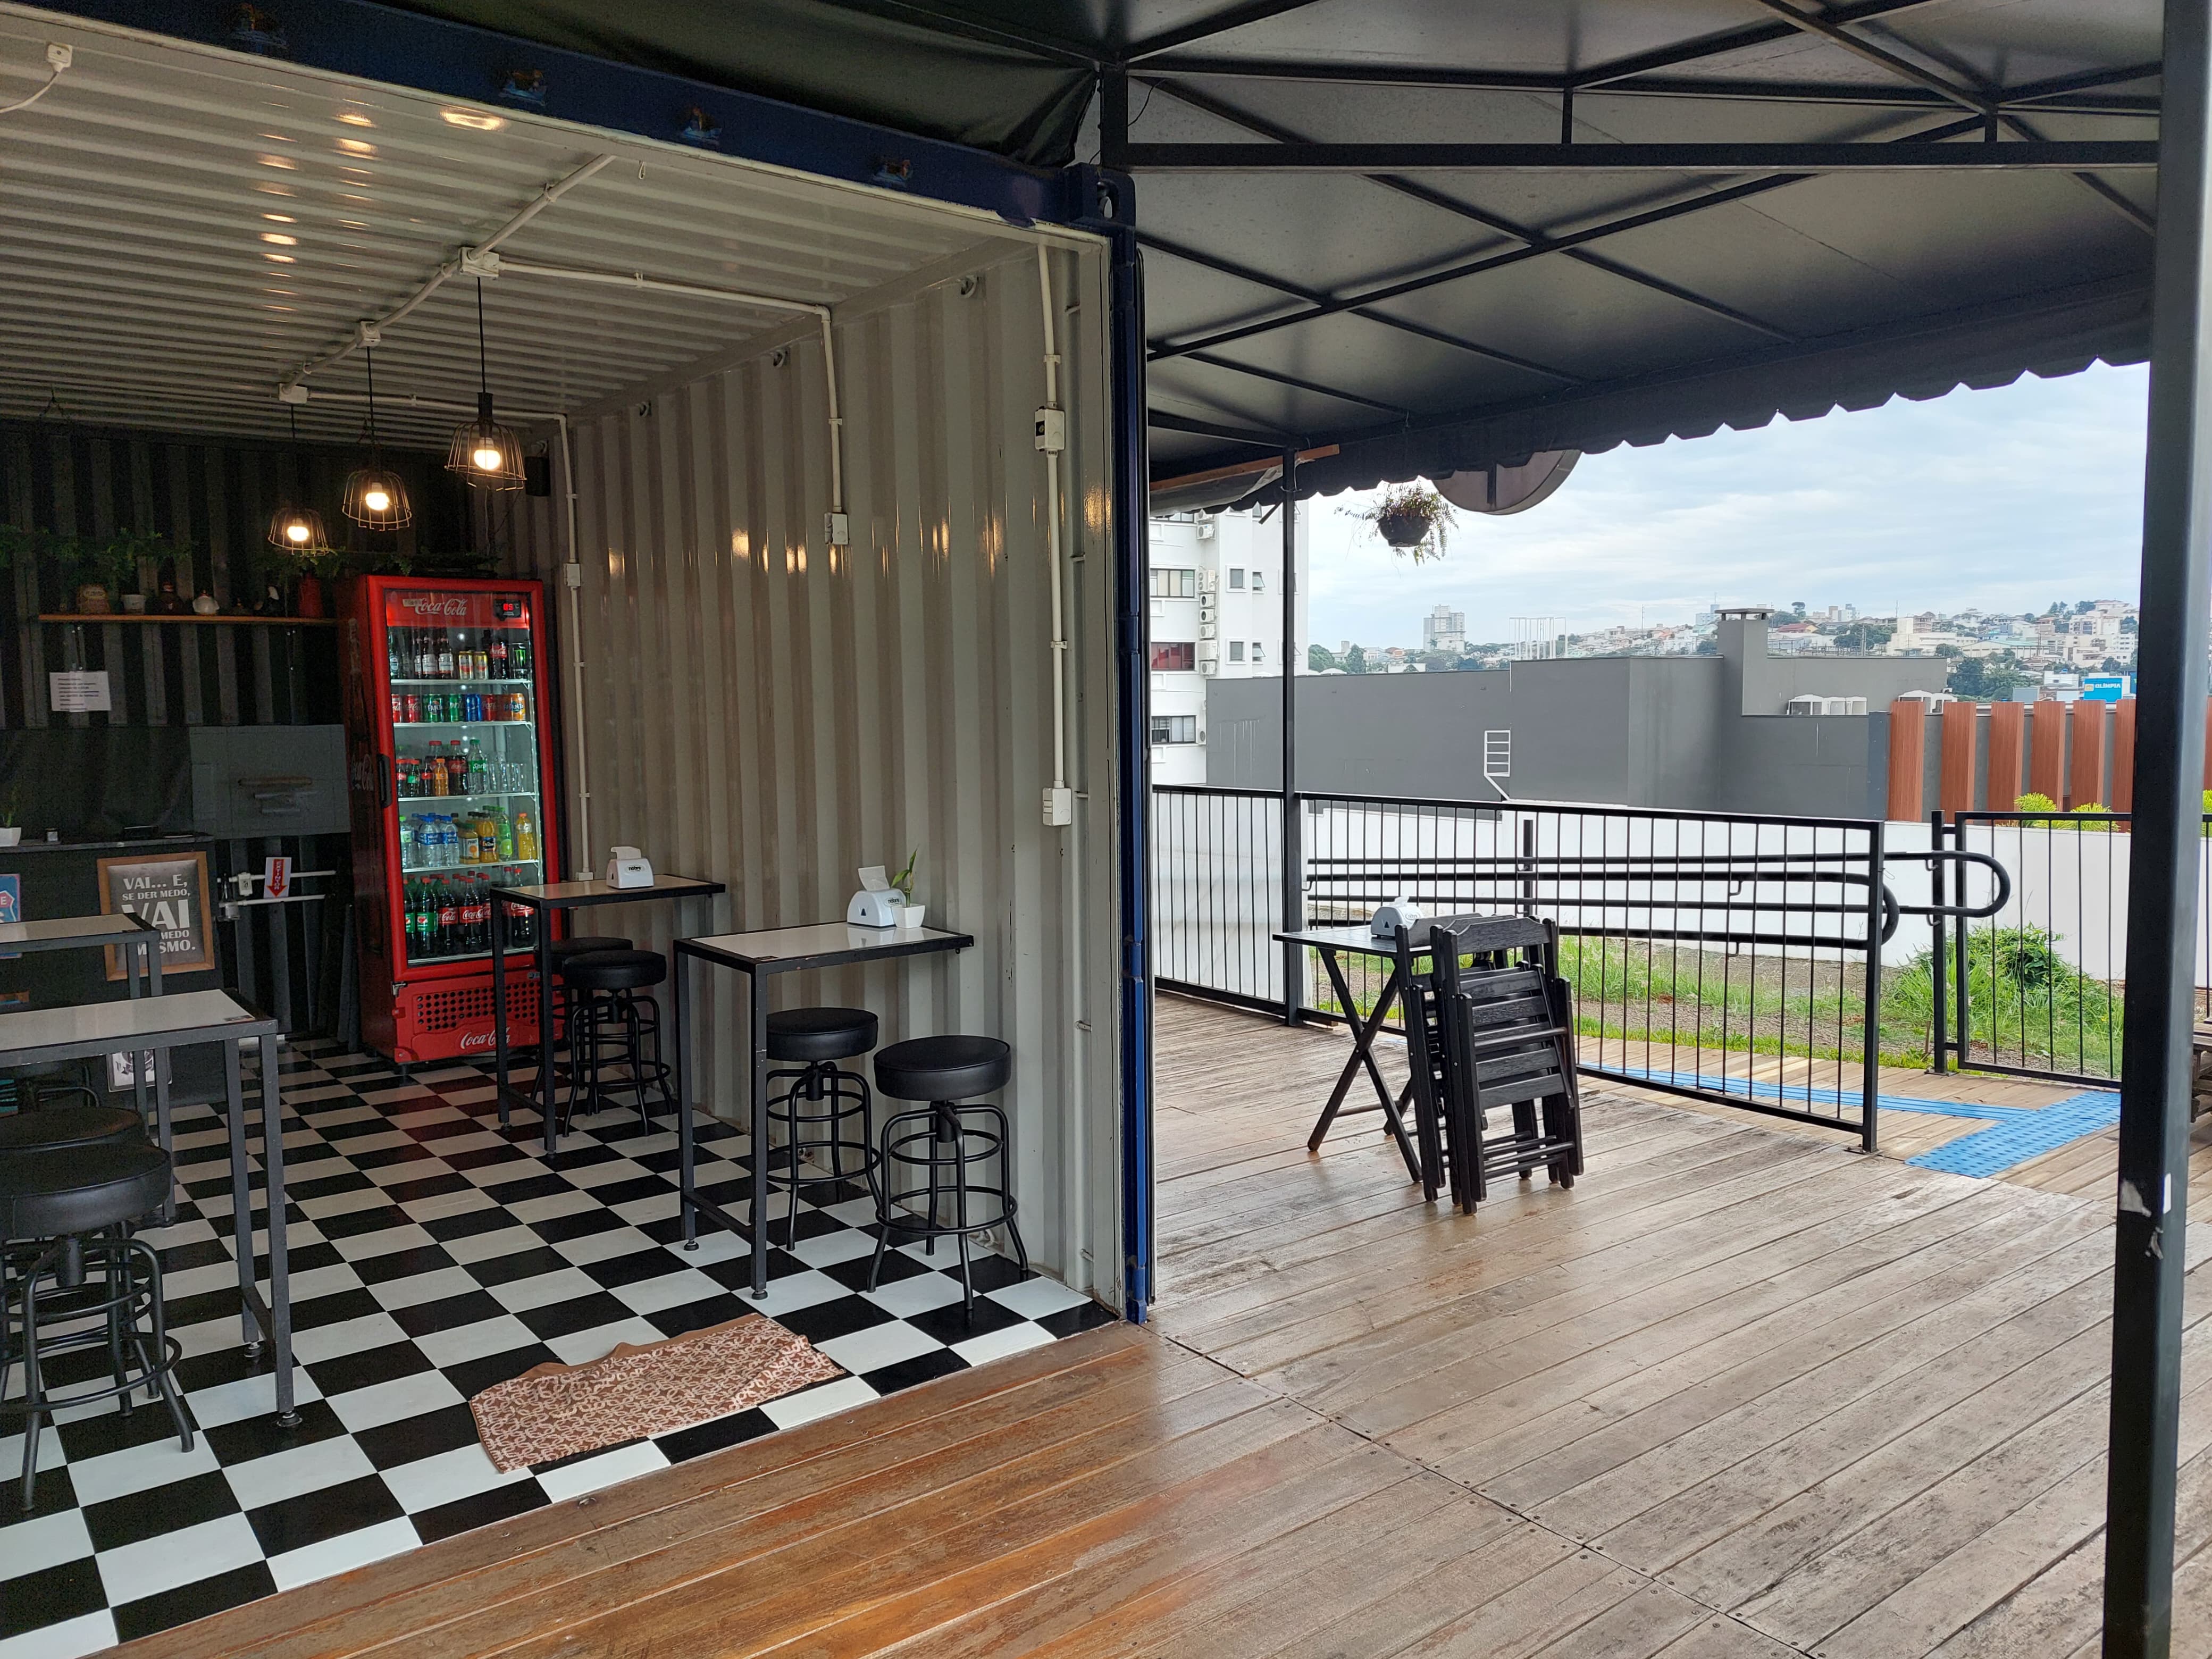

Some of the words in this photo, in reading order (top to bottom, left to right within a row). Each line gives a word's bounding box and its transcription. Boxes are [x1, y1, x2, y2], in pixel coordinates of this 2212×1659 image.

[123, 877, 166, 890] VAI...
[173, 874, 188, 887] E,
[138, 891, 157, 900] DER
[160, 889, 190, 897] MEDO,
[137, 940, 196, 956] MSMO.
